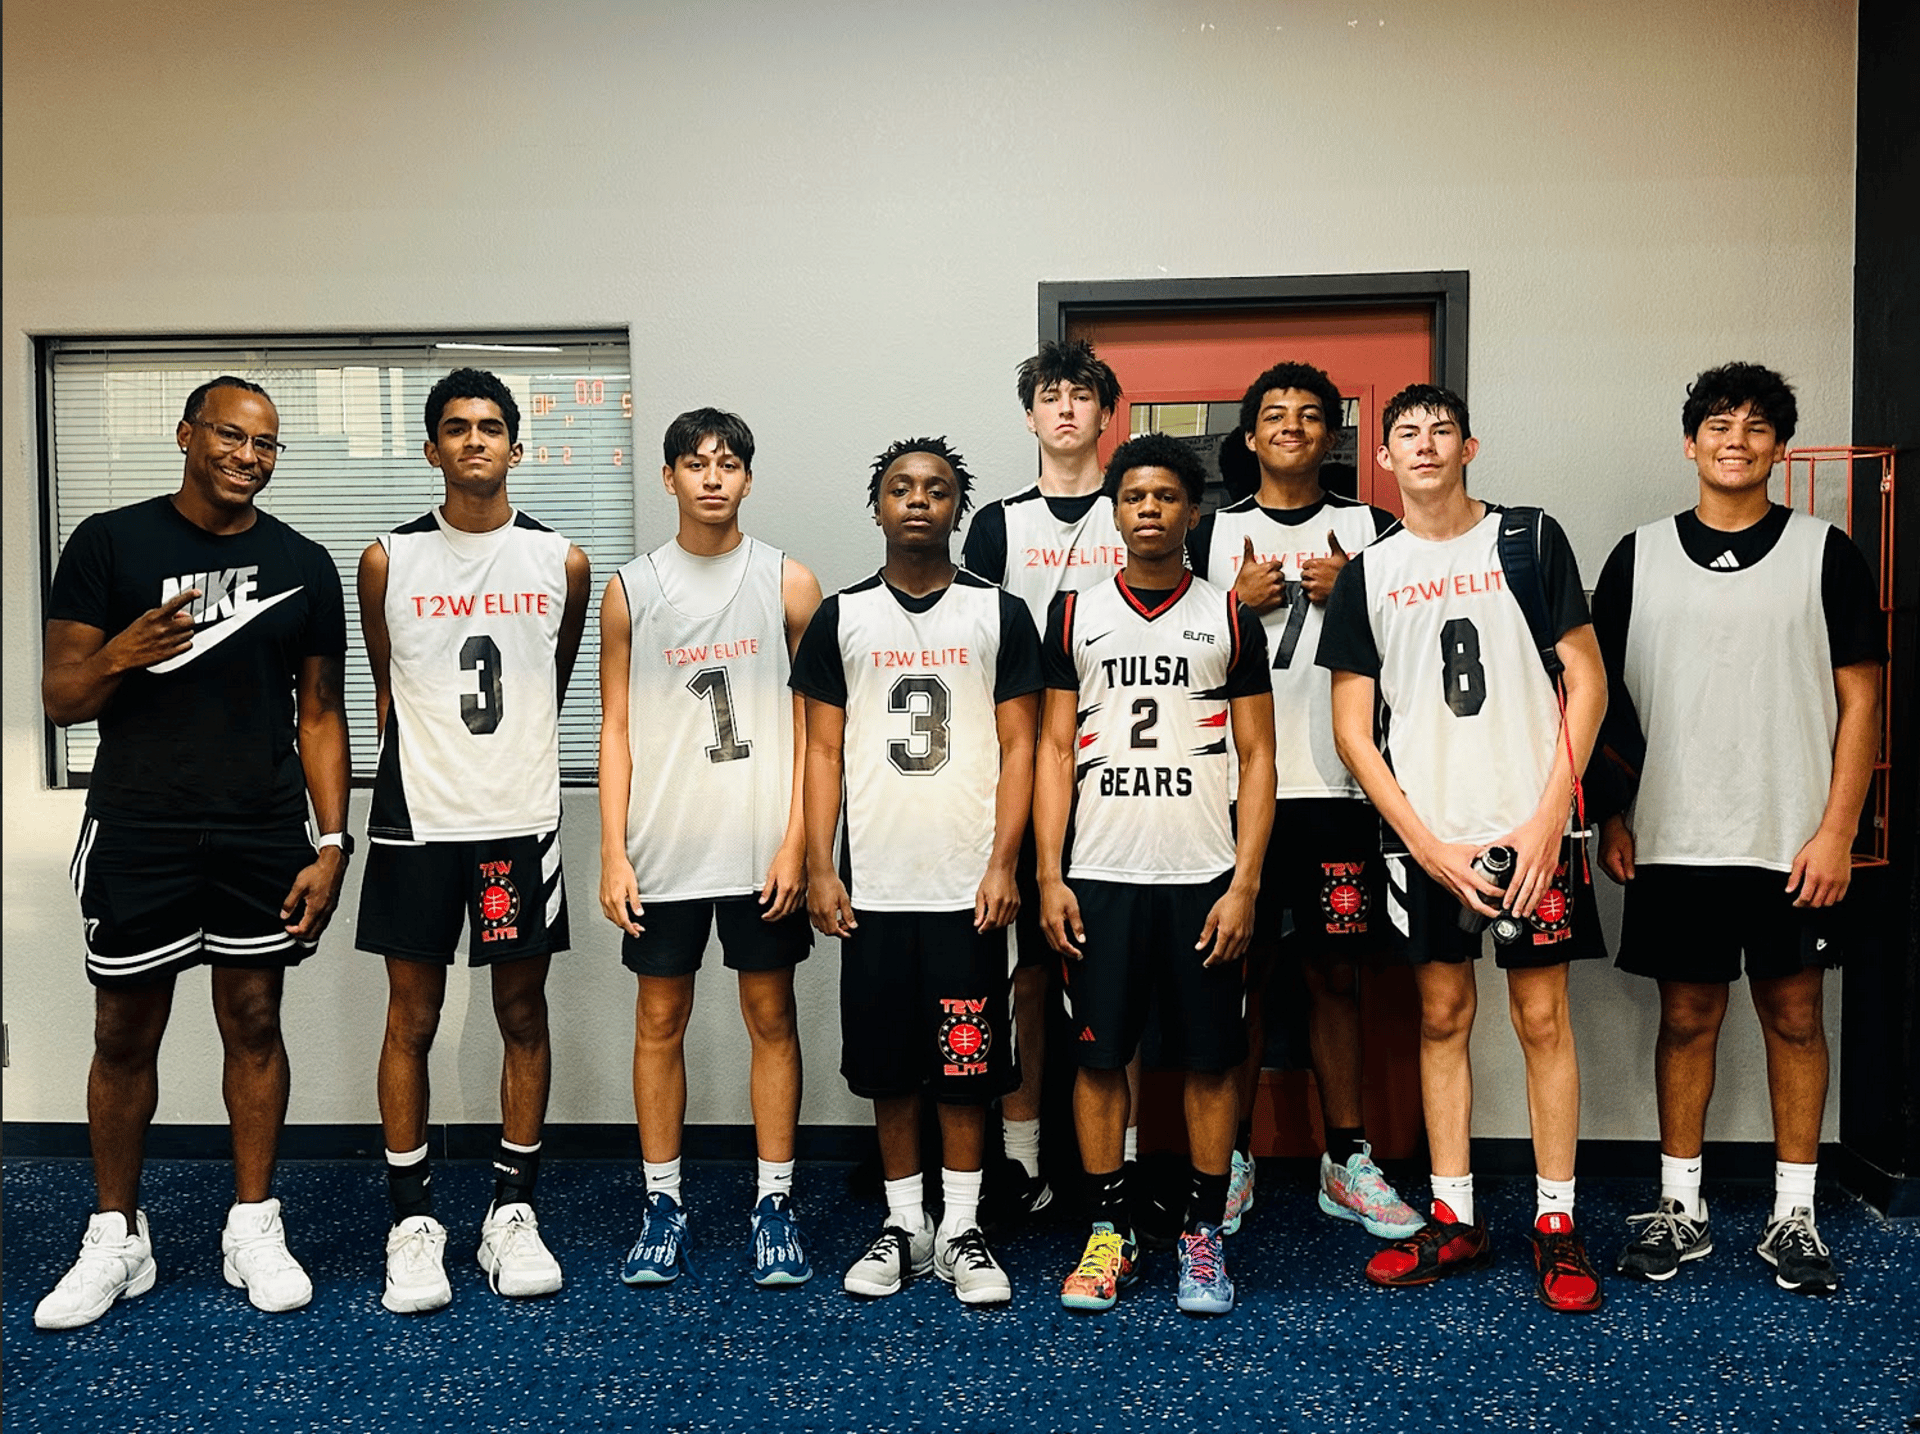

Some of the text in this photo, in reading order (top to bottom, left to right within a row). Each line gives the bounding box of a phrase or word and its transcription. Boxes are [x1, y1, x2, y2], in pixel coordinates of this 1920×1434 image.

[1067, 546, 1124, 566] ELITE
[161, 565, 258, 624] NIKE
[411, 593, 549, 617] T2W ELITE
[1388, 569, 1503, 609] T2W ELIT
[1183, 630, 1215, 644] ELITE
[1272, 580, 1311, 669] 7
[664, 638, 759, 666] T2W ELITE
[871, 648, 969, 668] T2W ELITE
[1101, 655, 1190, 689] TULSA
[1440, 617, 1487, 718] 8
[459, 634, 503, 736] 3
[686, 665, 753, 764] 1
[887, 674, 951, 776] 3
[1130, 698, 1158, 749] 2
[1100, 767, 1192, 797] BEARS
